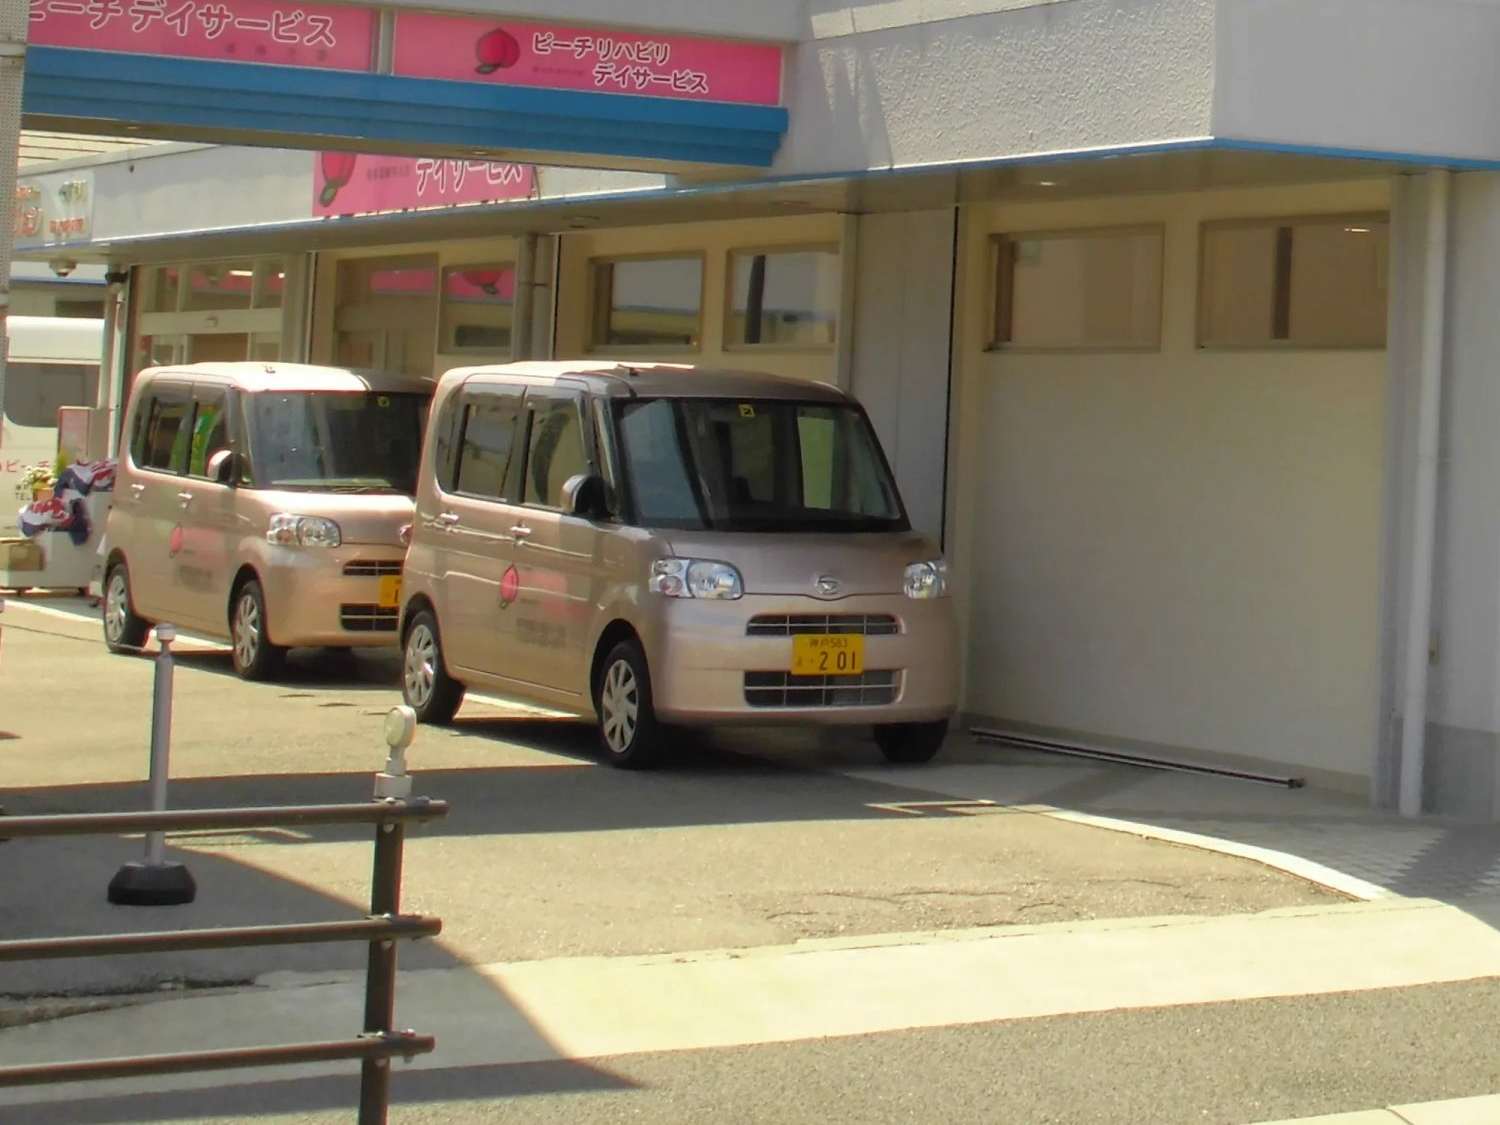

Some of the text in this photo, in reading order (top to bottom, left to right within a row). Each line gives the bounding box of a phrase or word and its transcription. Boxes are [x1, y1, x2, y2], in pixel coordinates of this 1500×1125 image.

[533, 32, 670, 65] ピーチリハビリ
[593, 62, 709, 93] デイサービス
